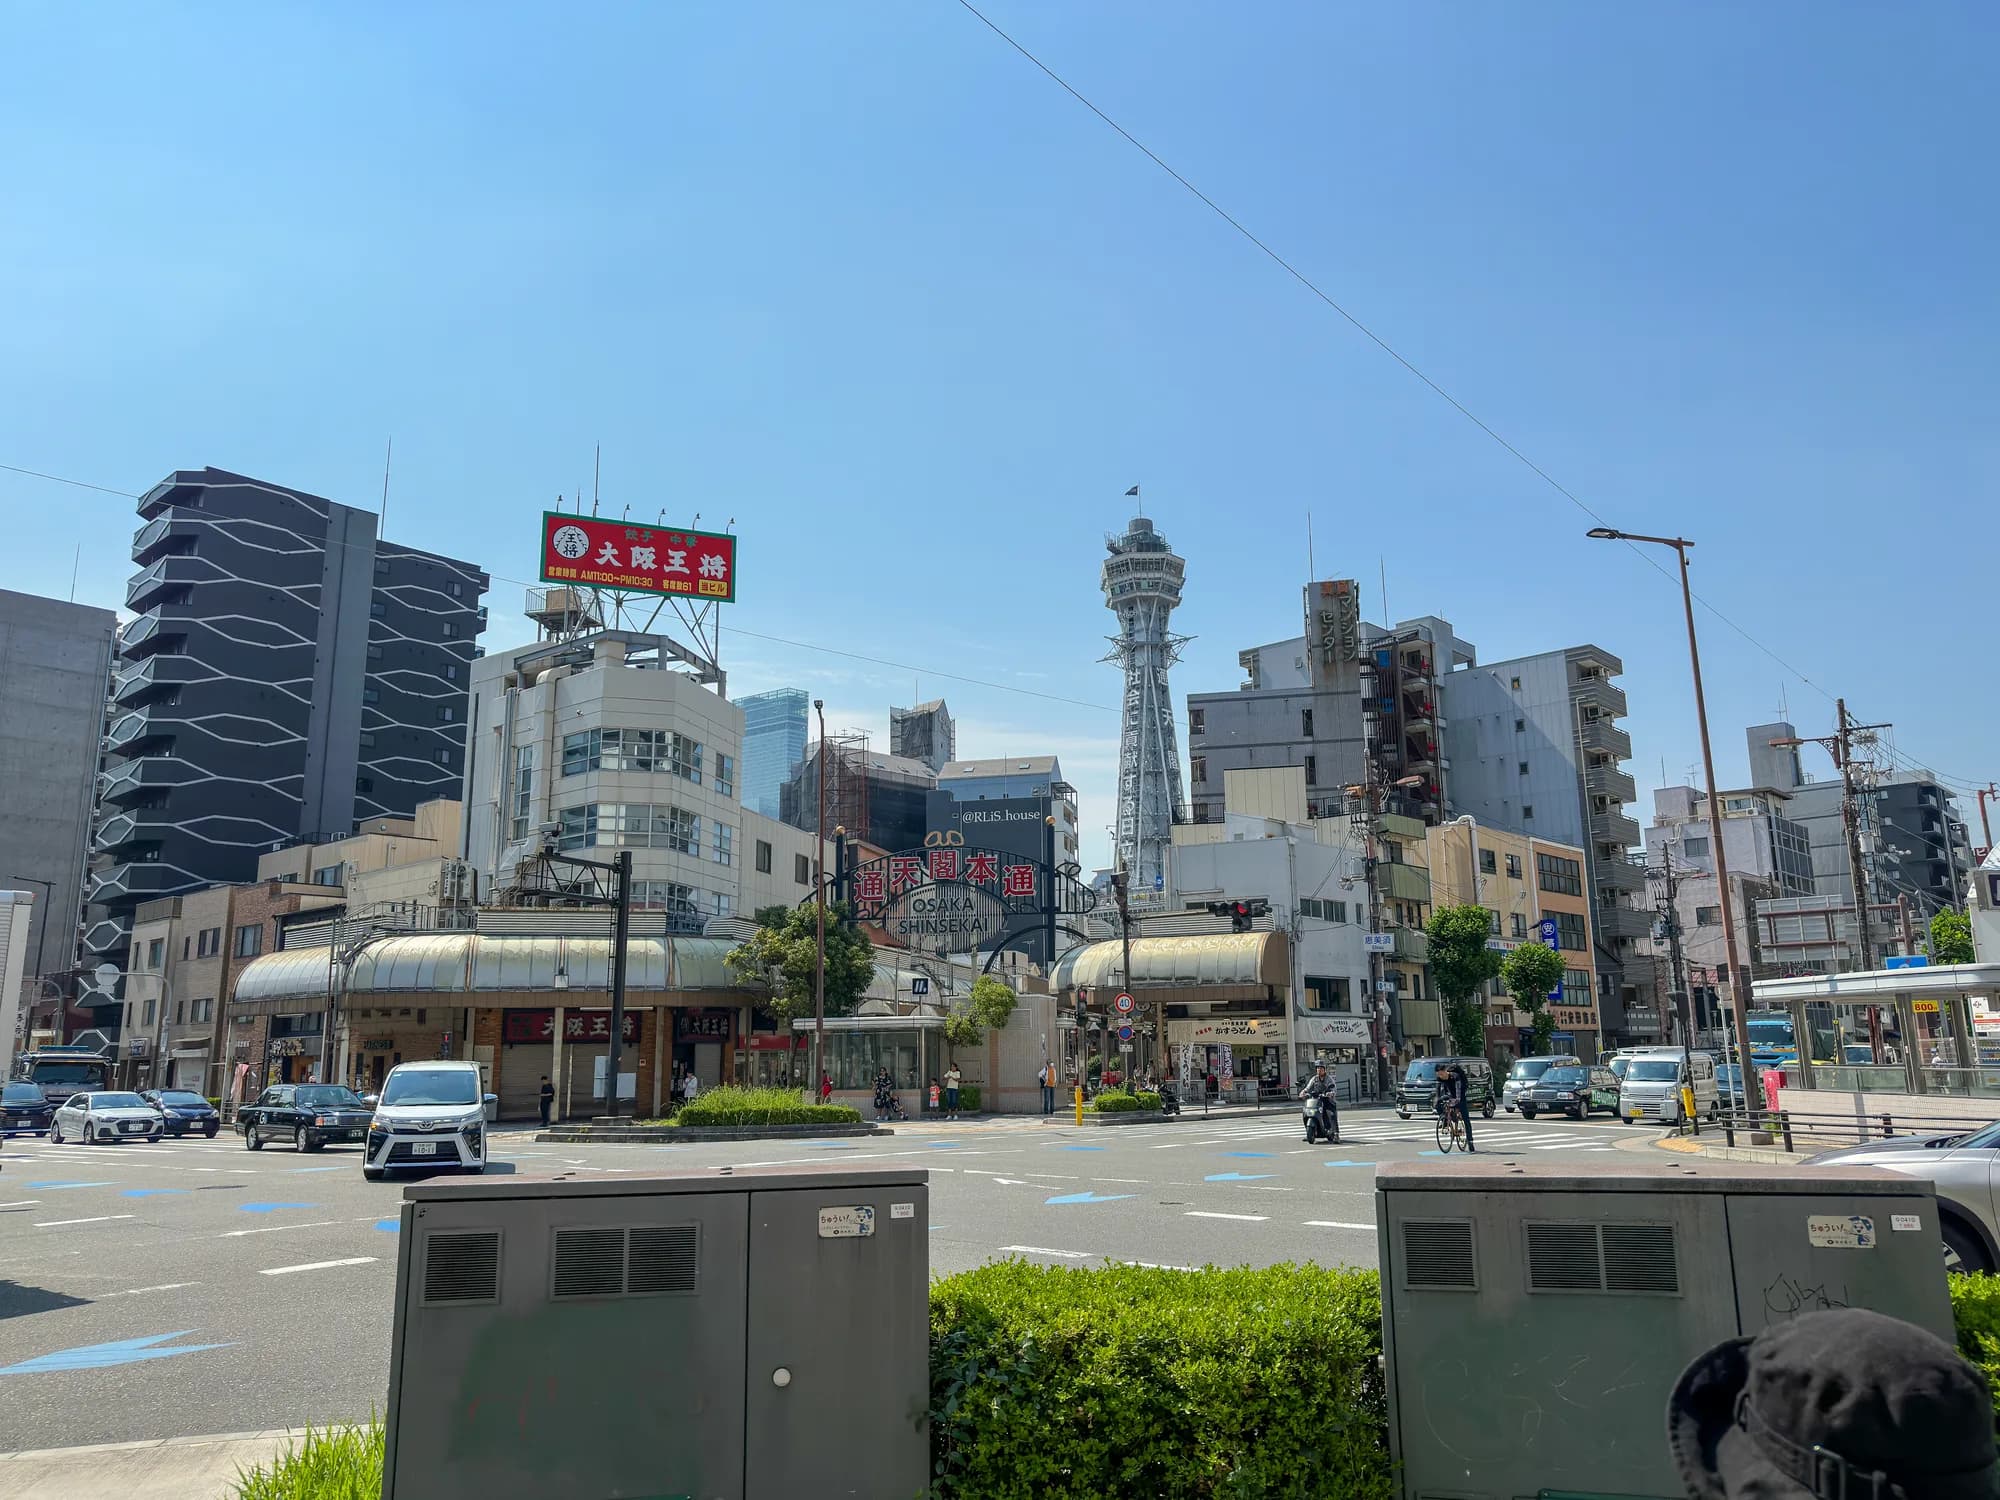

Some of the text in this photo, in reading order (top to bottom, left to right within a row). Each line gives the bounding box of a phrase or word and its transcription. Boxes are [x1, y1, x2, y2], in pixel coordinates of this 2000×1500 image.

[594, 541, 728, 581] 大阪王将
[1320, 611, 1335, 663] センター
[1339, 595, 1355, 662] マンション
[853, 850, 1036, 903] 通天閣本通
[912, 897, 975, 914] OSAKA
[899, 917, 988, 935] SHINSEKAI
[1119, 998, 1130, 1008] 40
[1215, 1026, 1256, 1035] かすうどん
